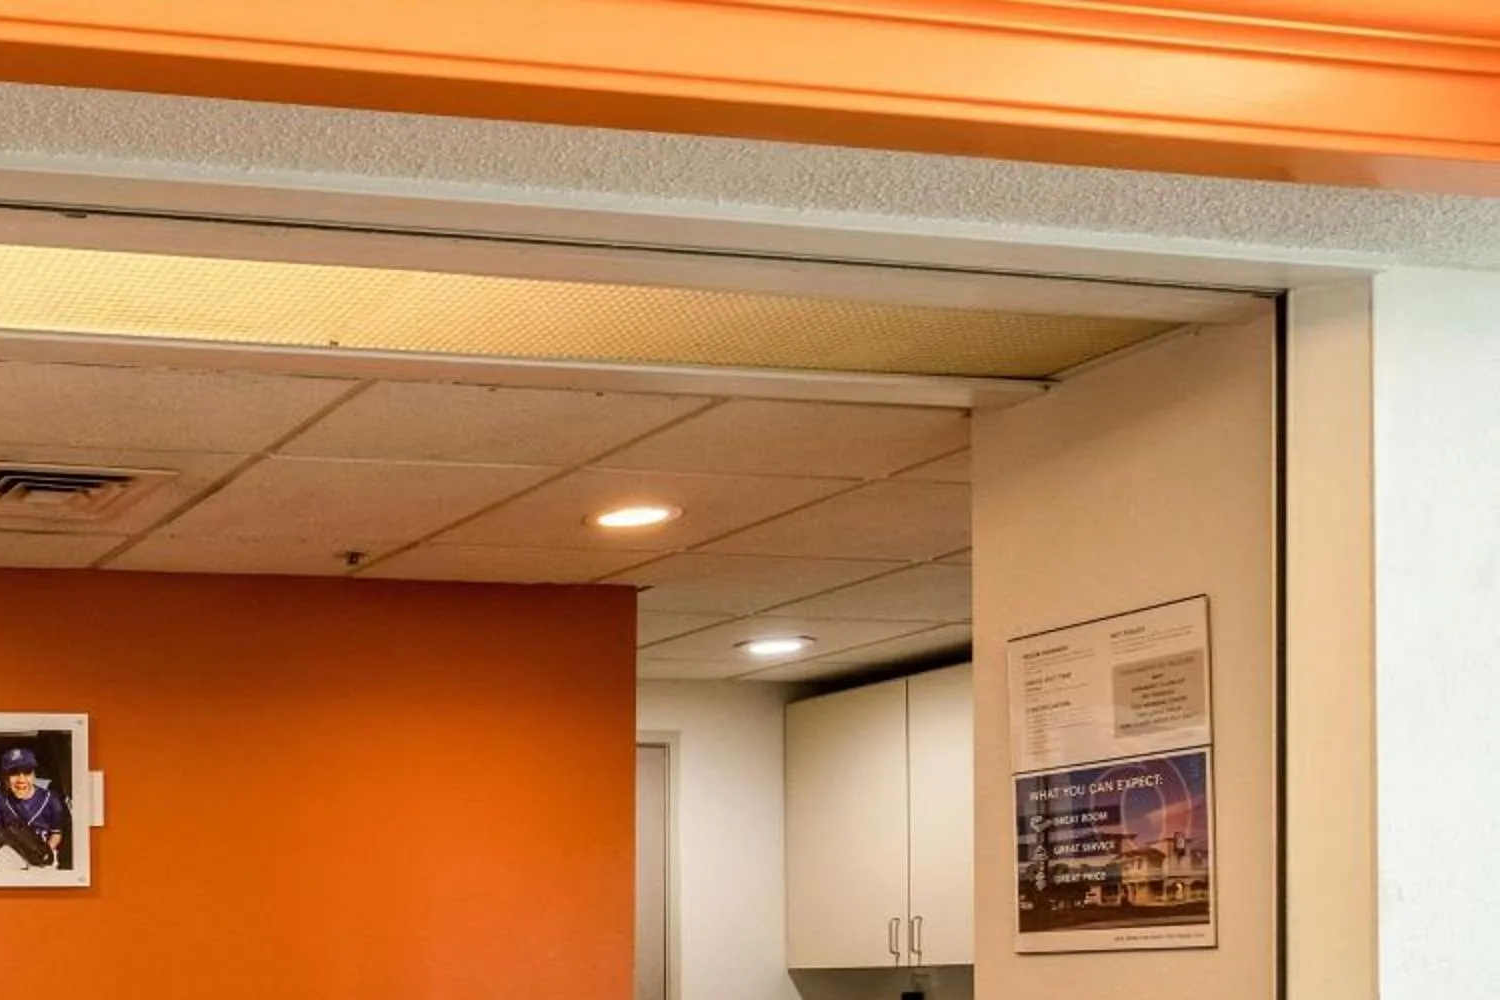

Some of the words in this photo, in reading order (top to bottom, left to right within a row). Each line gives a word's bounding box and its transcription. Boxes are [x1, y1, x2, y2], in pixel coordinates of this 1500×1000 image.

[1030, 788, 1060, 801] WHAT
[1063, 783, 1086, 797] YOU
[1090, 780, 1115, 794] CAN
